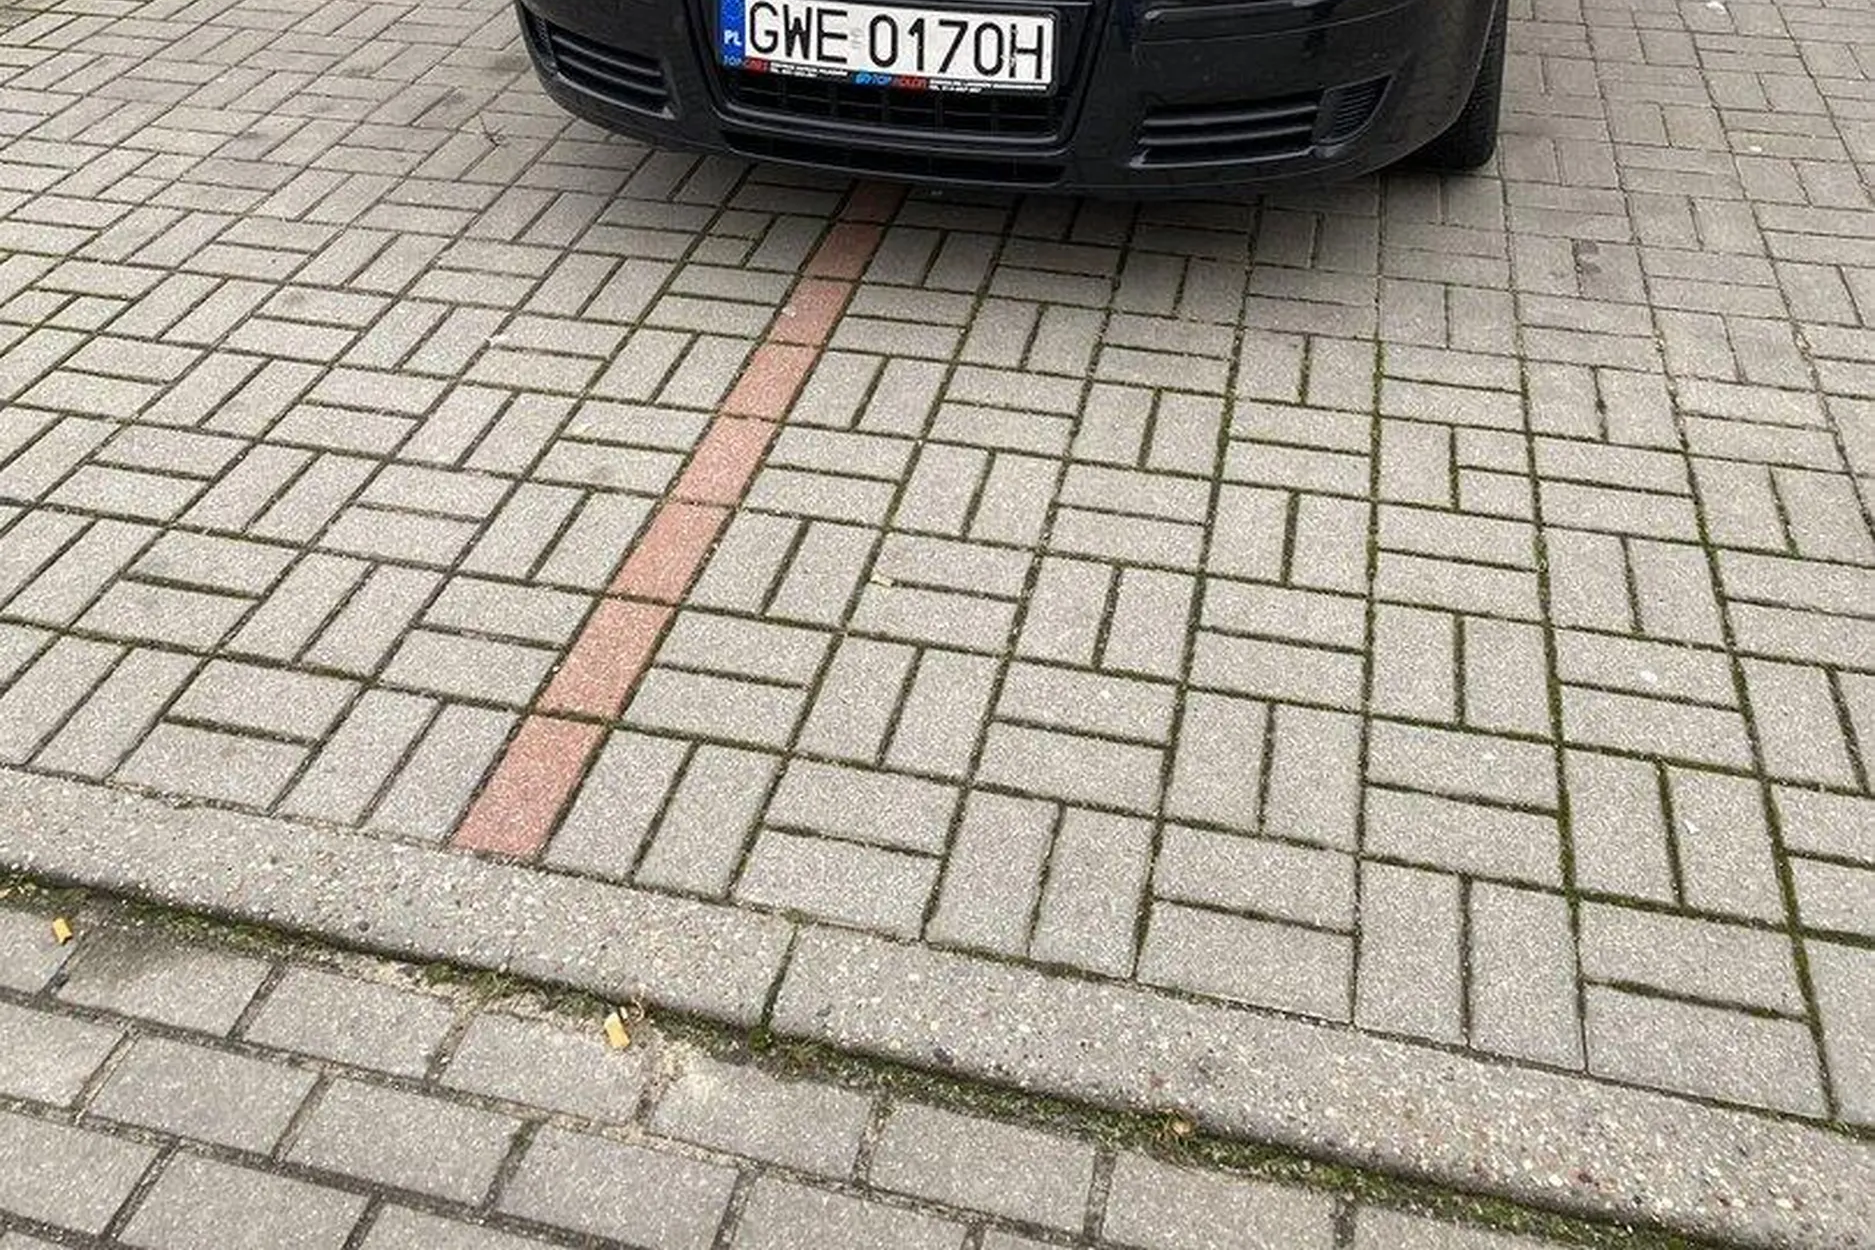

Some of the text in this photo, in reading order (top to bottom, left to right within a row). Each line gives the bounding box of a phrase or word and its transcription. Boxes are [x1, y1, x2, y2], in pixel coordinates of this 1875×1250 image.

[723, 30, 742, 47] PL
[749, 0, 1046, 80] GWE 0170H
